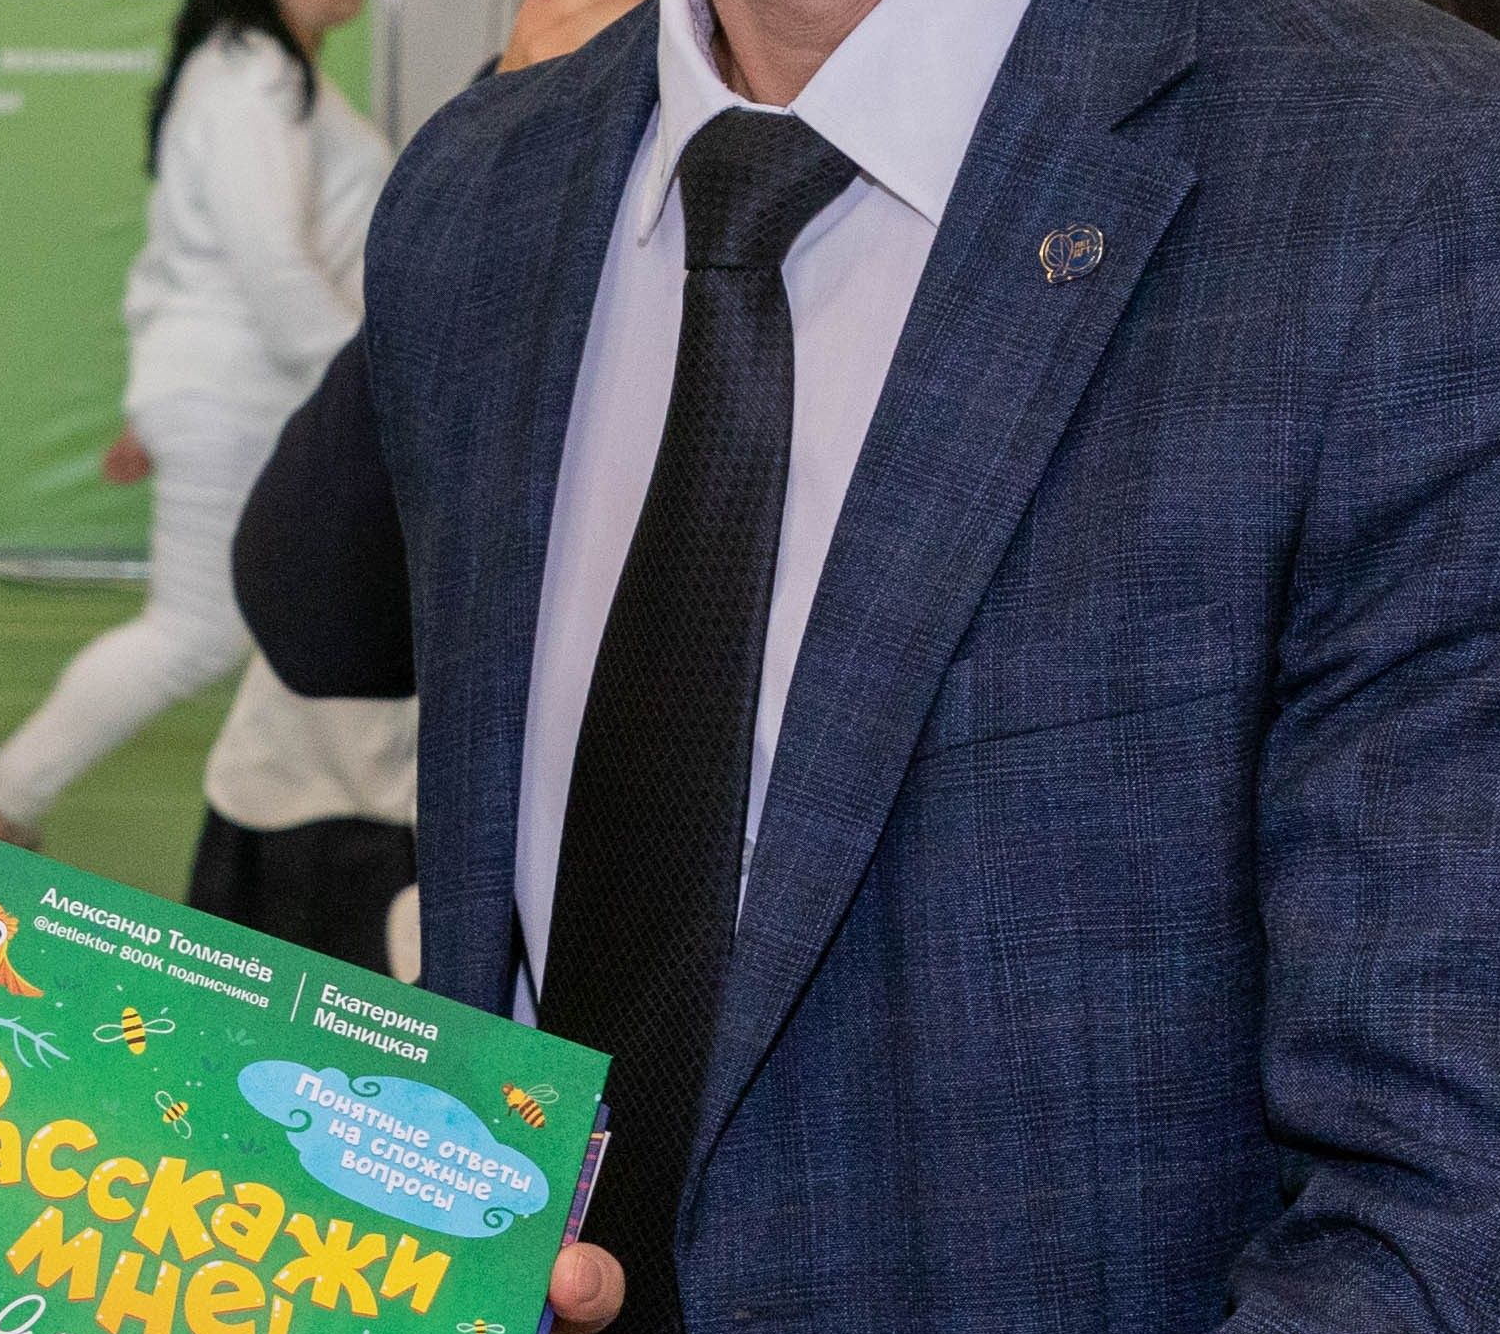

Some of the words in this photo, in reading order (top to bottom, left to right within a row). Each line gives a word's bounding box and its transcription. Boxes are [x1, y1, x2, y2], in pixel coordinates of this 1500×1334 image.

[34, 915, 117, 955] @detlektor
[167, 964, 270, 1008] подписчиков
[40, 887, 160, 945] Александр
[167, 930, 273, 983] Толмачёв
[313, 1007, 429, 1063] Маницкая
[321, 984, 439, 1041] Екатерина
[295, 1073, 430, 1148] Понятные
[438, 1141, 532, 1192] ответы
[328, 1119, 361, 1145] на
[370, 1137, 493, 1200] сложные
[340, 1150, 455, 1211] вопросы
